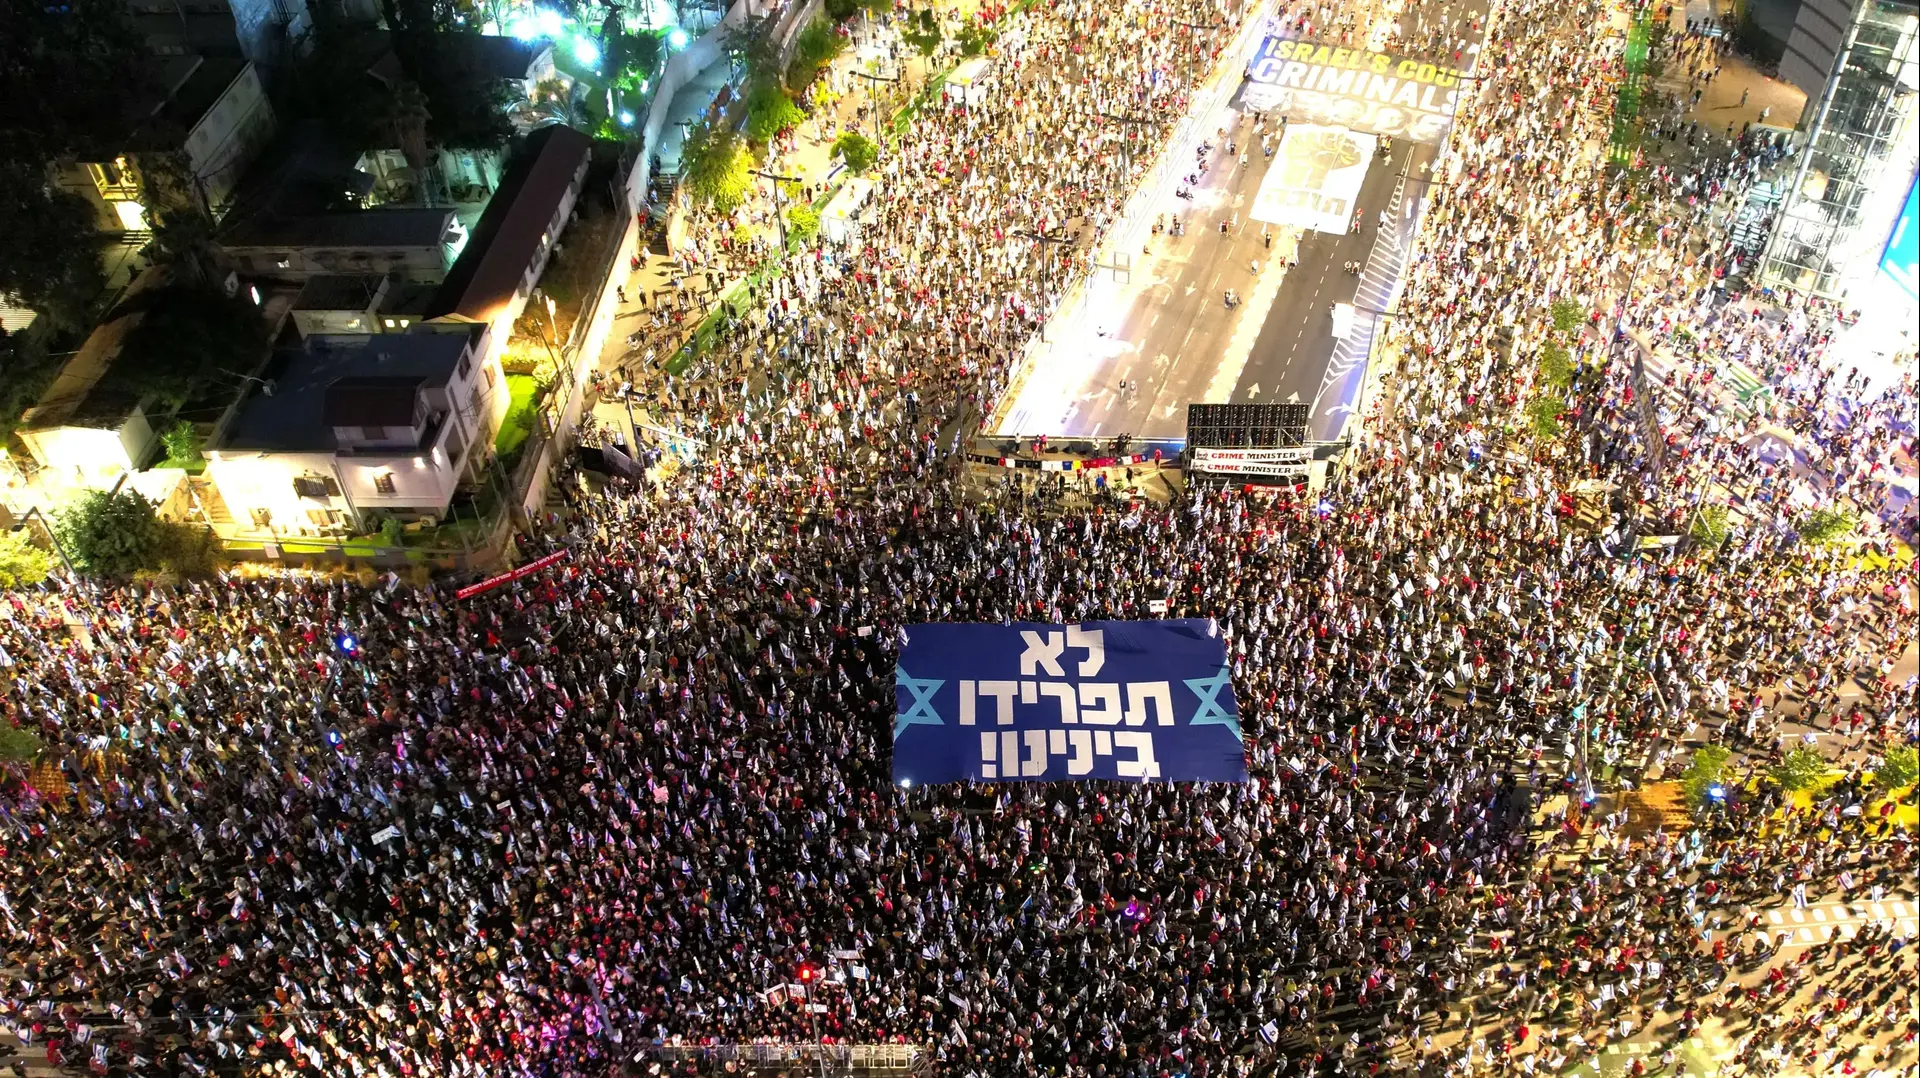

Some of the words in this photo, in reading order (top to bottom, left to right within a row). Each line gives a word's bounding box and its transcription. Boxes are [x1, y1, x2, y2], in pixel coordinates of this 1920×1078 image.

[1251, 57, 1462, 115] CRIMINALS
[1265, 37, 1391, 74] ISRAEL'S
[1396, 60, 1464, 89] COU
[1207, 464, 1240, 472] CRIME
[1242, 465, 1291, 473] MINISTER
[1020, 624, 1105, 677] לא
[959, 679, 1175, 726] תפרידו
[981, 729, 1161, 778] בינינו!
